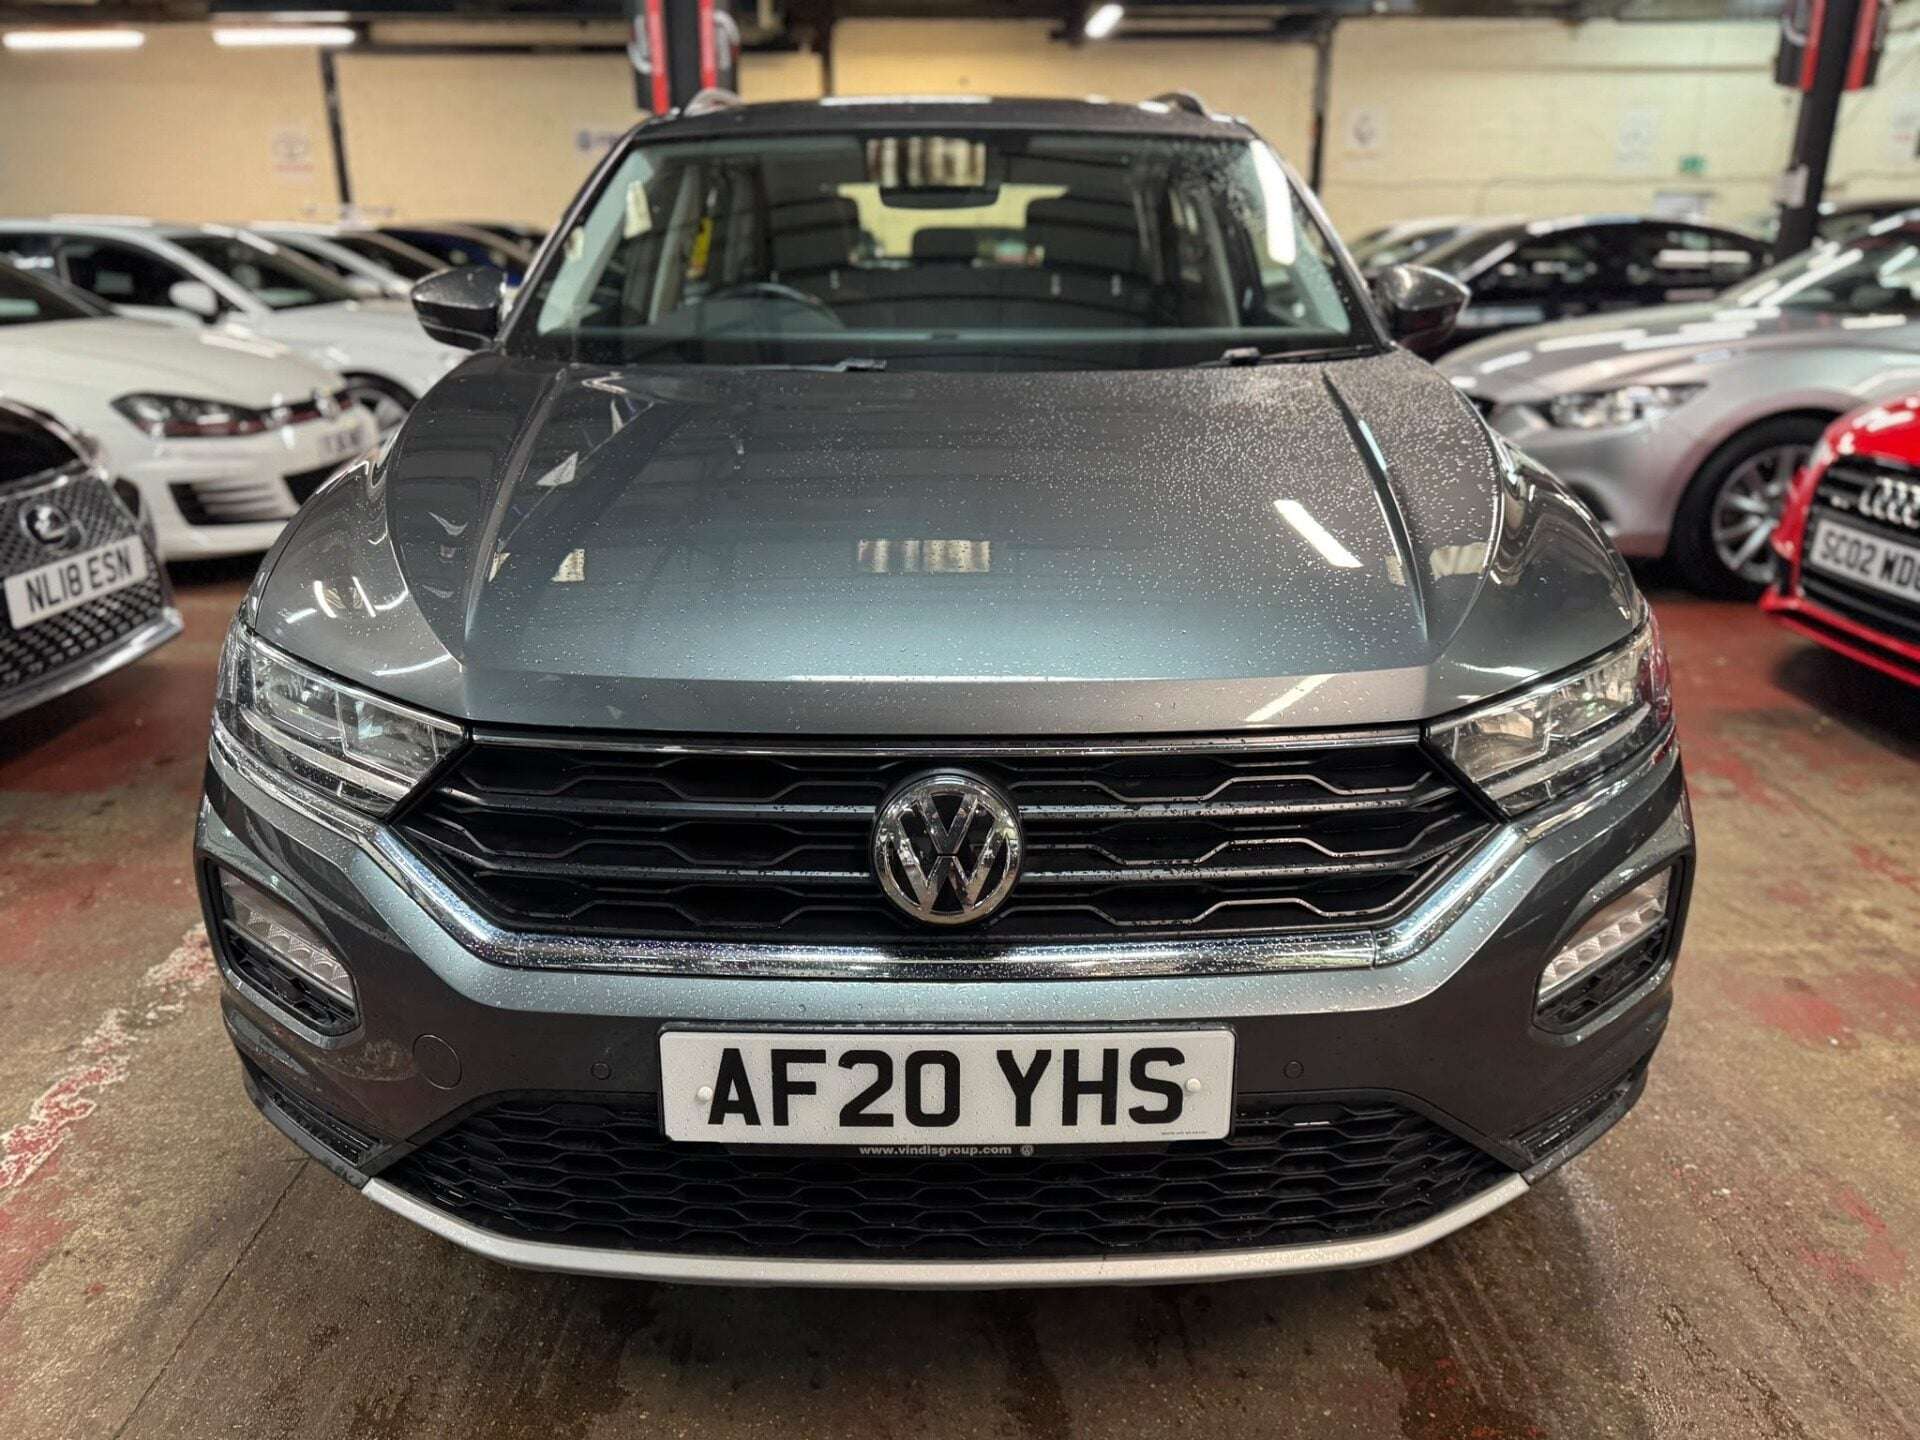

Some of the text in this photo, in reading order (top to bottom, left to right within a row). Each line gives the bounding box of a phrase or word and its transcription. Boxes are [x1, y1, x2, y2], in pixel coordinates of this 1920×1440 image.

[25, 545, 132, 613] NL18 ESN
[707, 1047, 1186, 1127] AF20 YHS
[859, 1145, 1012, 1157] www.vindisgroup.com
